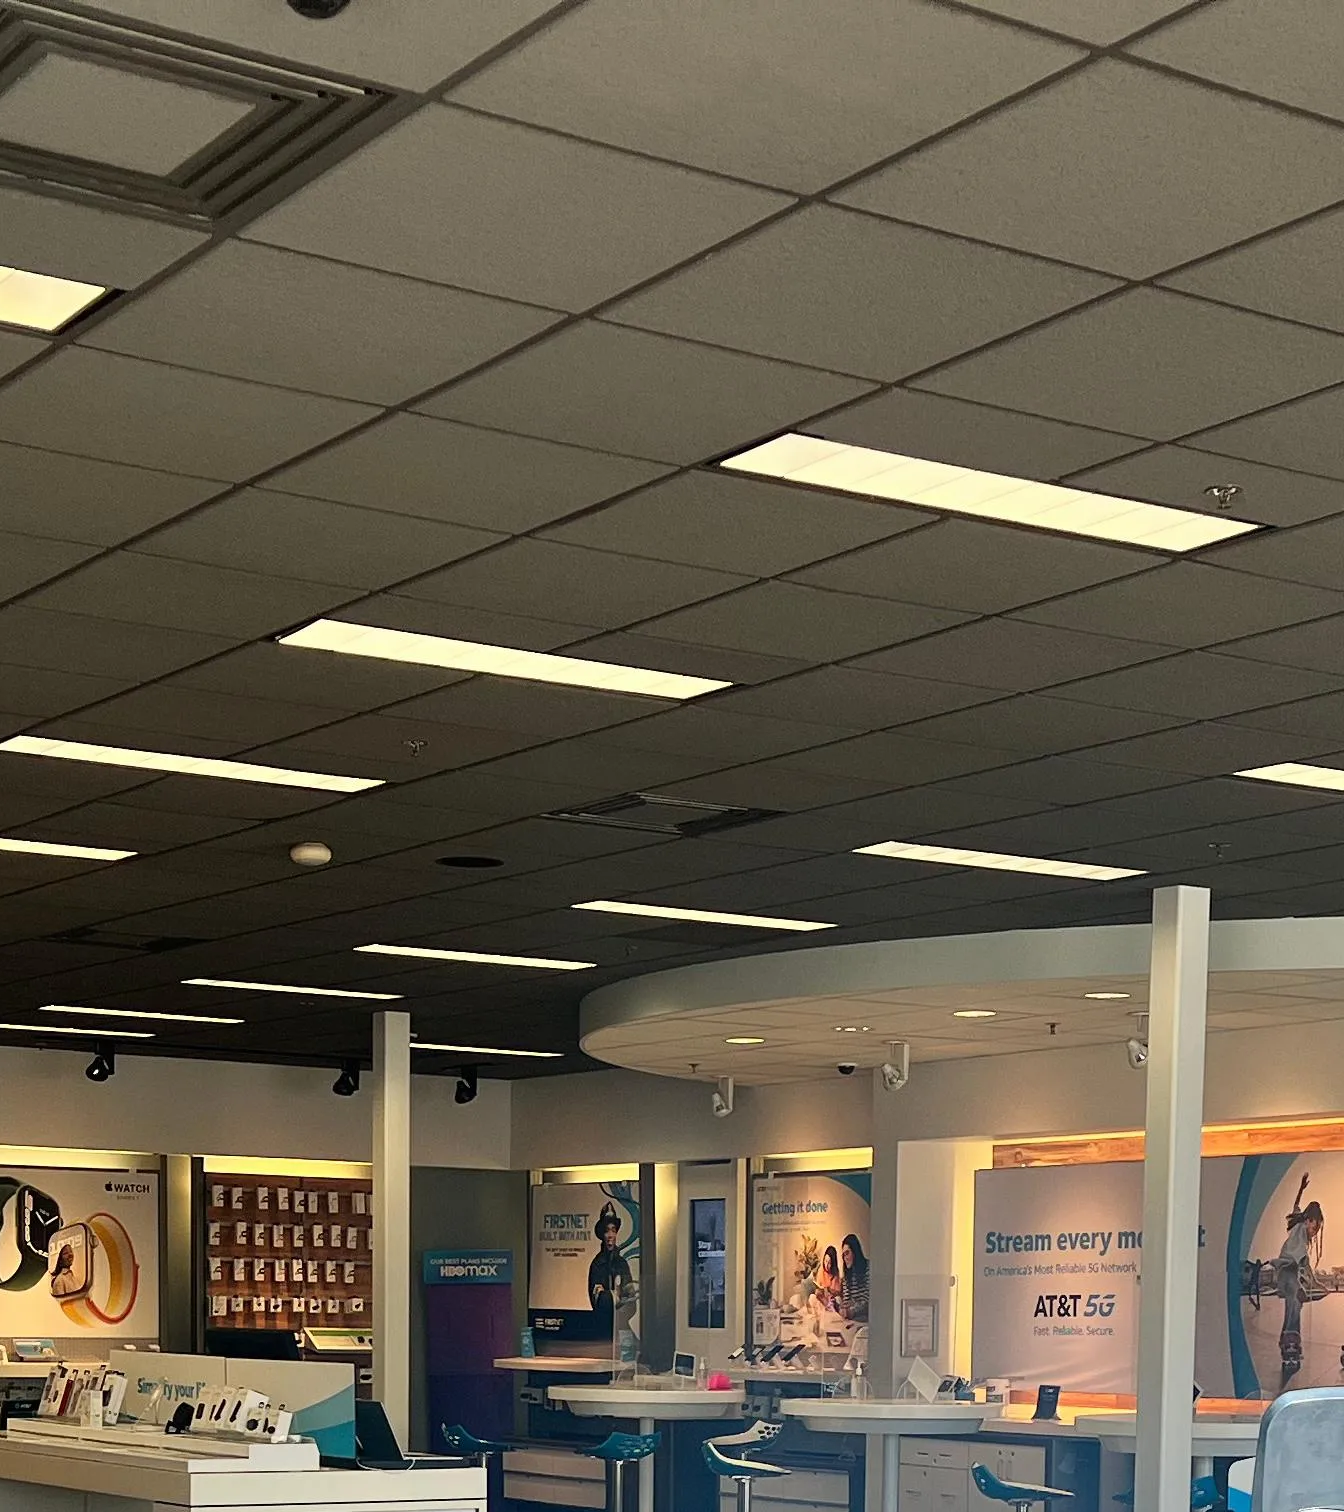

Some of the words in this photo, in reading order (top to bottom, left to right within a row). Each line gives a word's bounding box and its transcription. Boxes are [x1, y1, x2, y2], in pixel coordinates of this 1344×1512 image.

[114, 1183, 150, 1193] WATCH
[762, 1202, 795, 1217] Getting
[797, 1203, 805, 1214] it
[806, 1200, 828, 1213] done
[544, 1213, 590, 1229] FIRSTNET
[985, 1231, 1052, 1253] Stream
[1057, 1231, 1113, 1256] every
[984, 1266, 995, 1276] On
[996, 1265, 1032, 1276] America's
[1034, 1264, 1054, 1275] Most
[1056, 1263, 1086, 1274] Reliable
[1088, 1263, 1099, 1273] 5G
[1101, 1261, 1137, 1273] Network
[1034, 1294, 1081, 1318] AT&T
[1084, 1294, 1116, 1317] 5G
[175, 1384, 195, 1402] your
